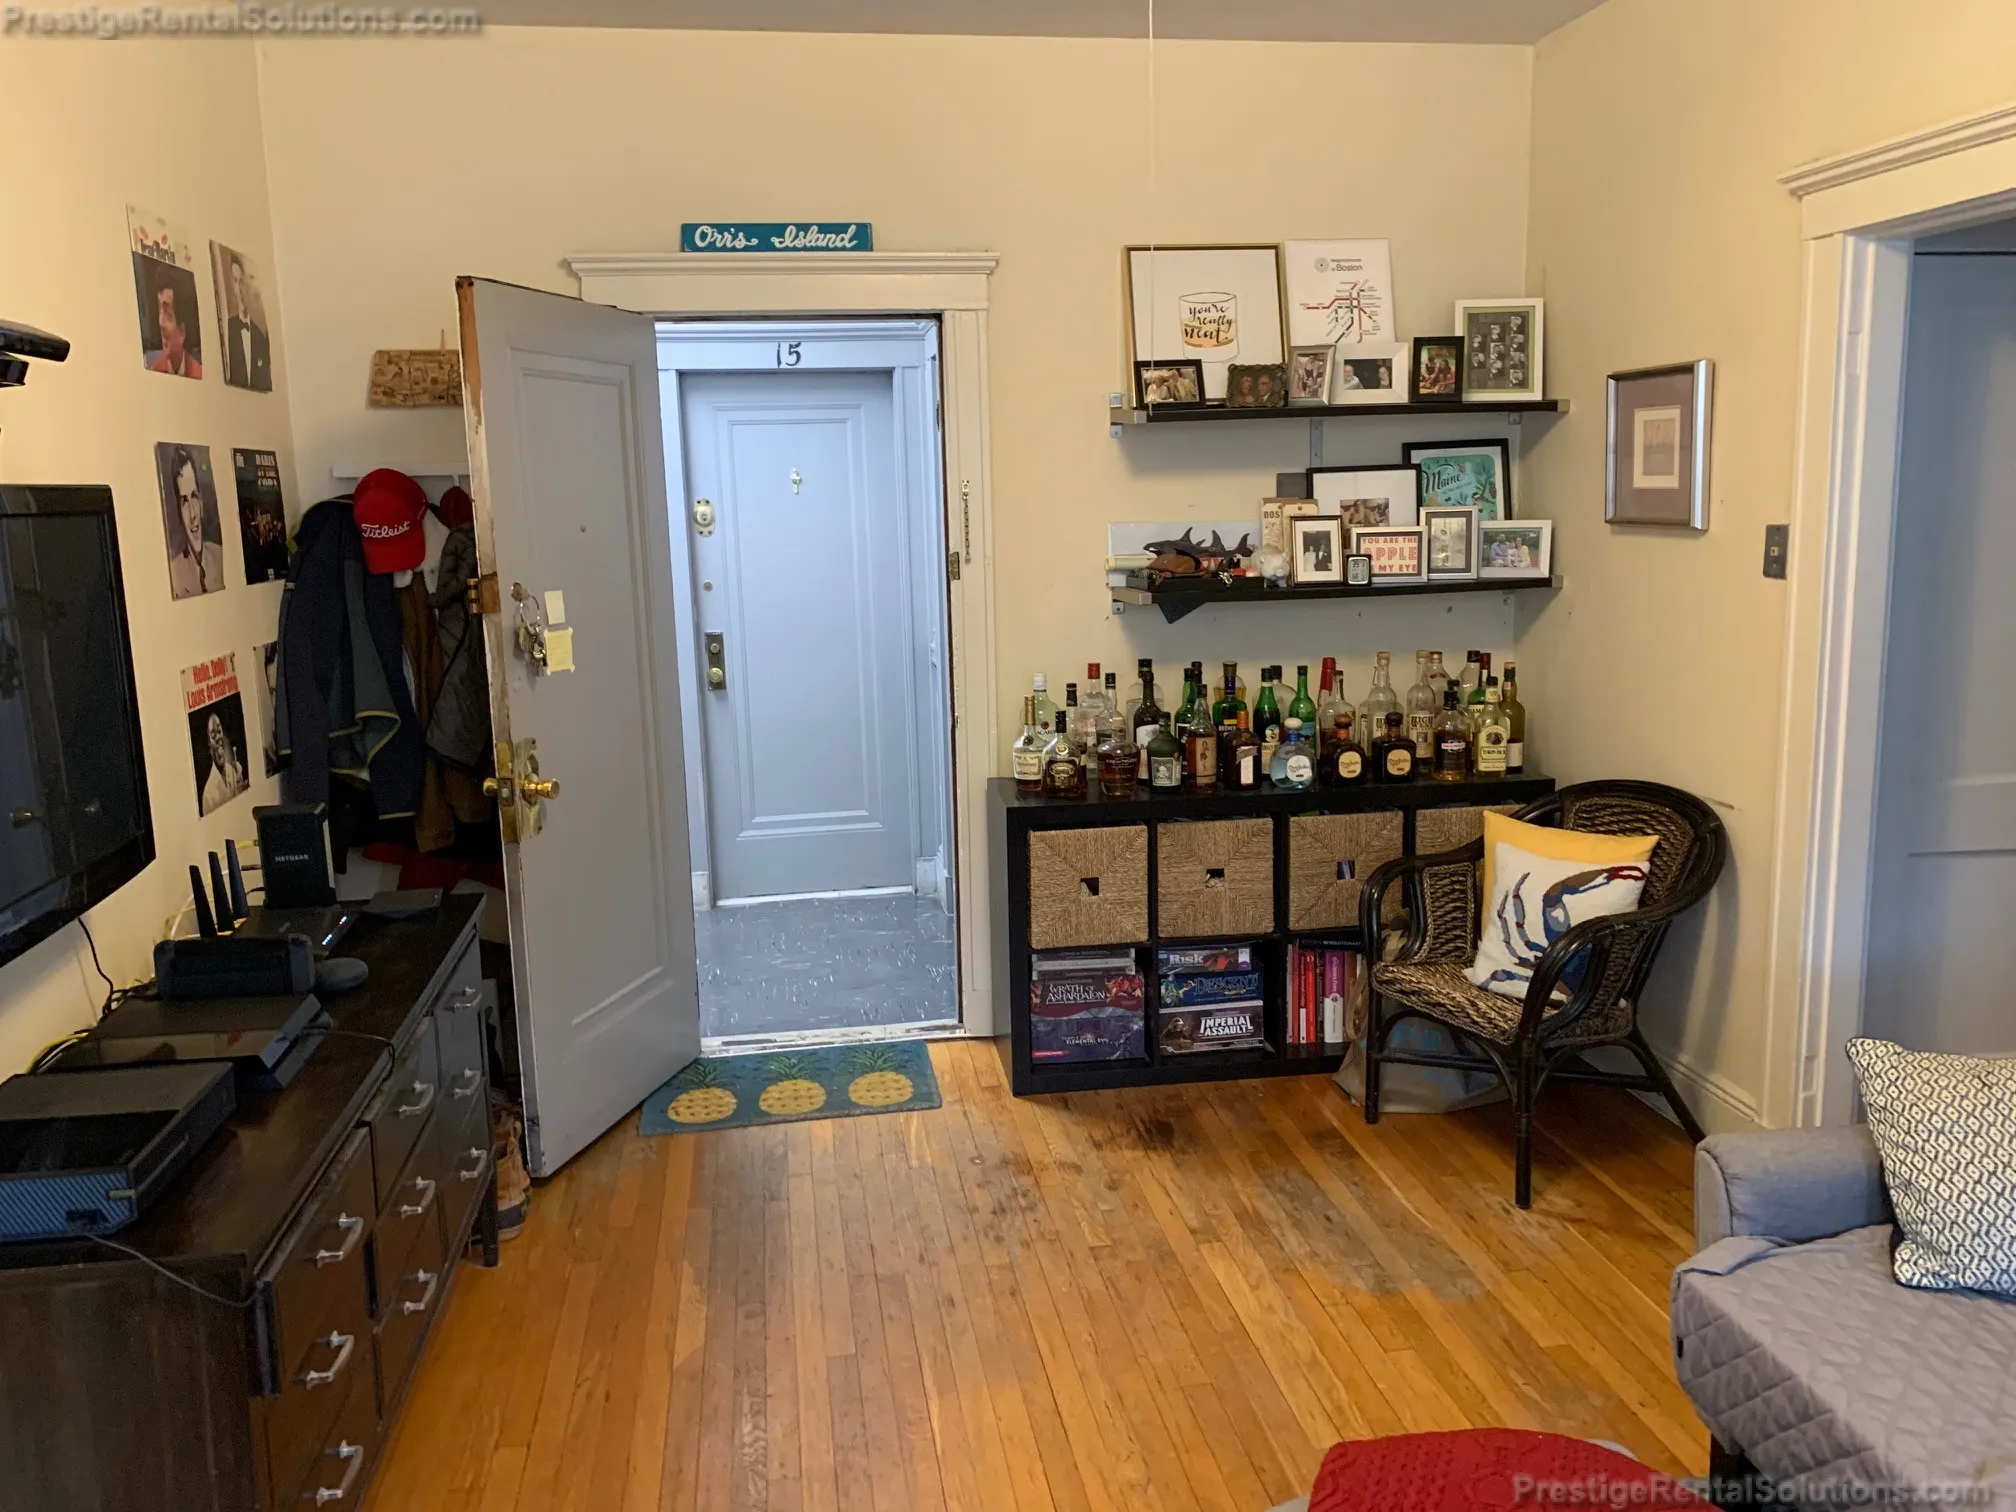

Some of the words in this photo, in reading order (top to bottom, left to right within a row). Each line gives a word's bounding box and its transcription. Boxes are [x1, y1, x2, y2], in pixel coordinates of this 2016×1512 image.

[694, 225, 758, 248] Orr's
[770, 224, 858, 248] Island
[776, 341, 802, 368] 15
[1421, 463, 1462, 496] Maine
[1264, 511, 1283, 519] BOS
[361, 520, 410, 538] Titleist
[1364, 546, 1418, 561] APPLE
[1379, 564, 1395, 572] MY
[1399, 564, 1418, 572] EYE
[1200, 1014, 1254, 1034] IMPERIAL
[1204, 1024, 1248, 1037] ASSAULT
